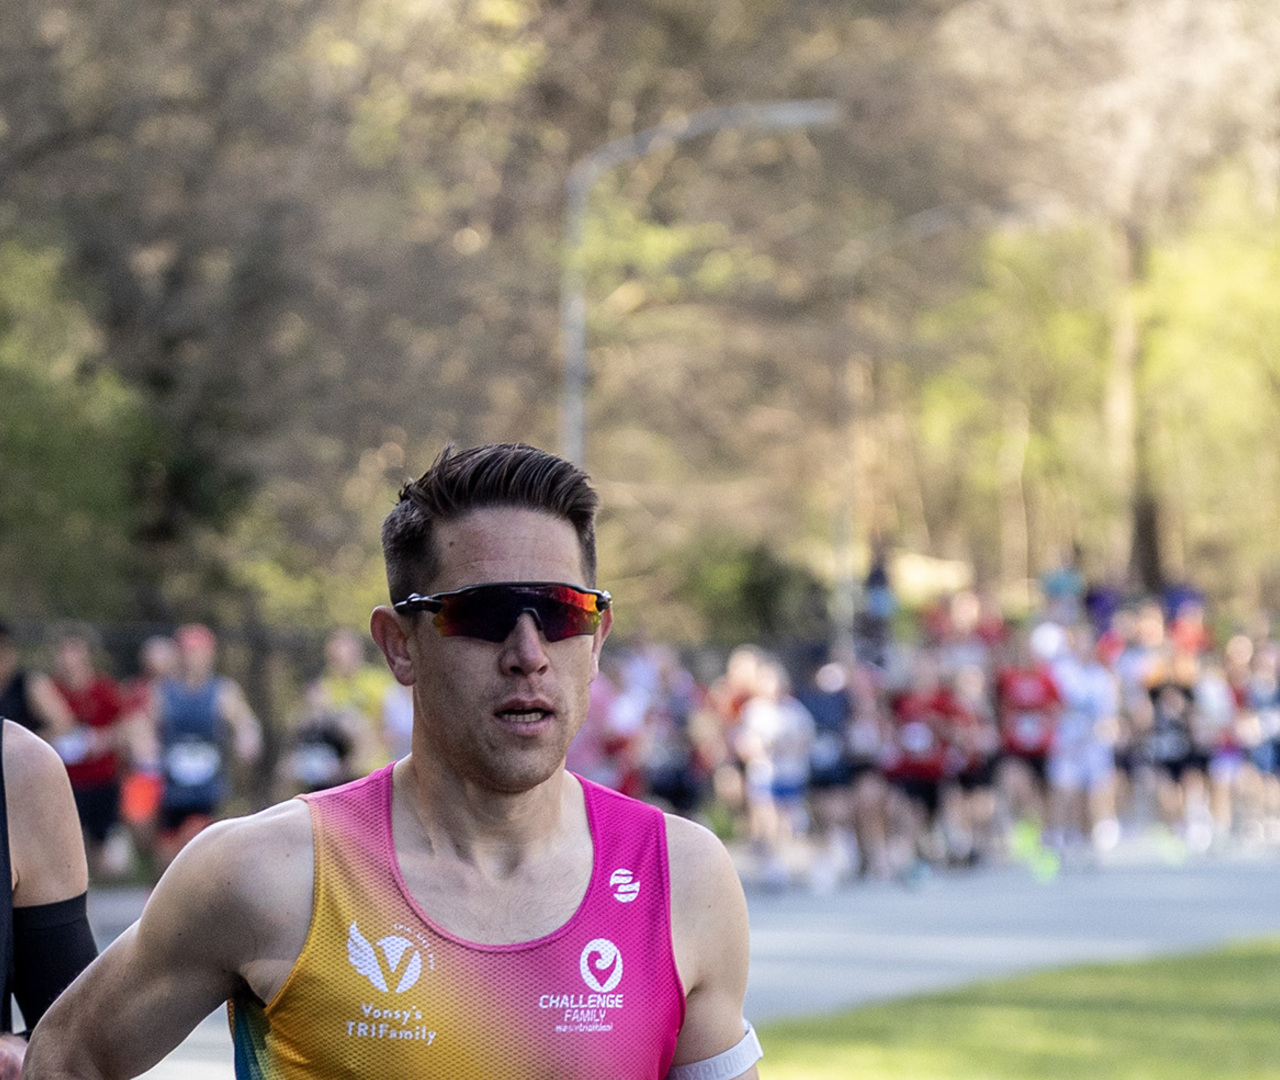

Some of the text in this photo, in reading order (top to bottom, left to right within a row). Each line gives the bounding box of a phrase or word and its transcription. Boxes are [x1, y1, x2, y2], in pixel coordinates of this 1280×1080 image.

[538, 994, 624, 1009] CHALLENGE
[361, 1003, 423, 1026] Vonsy's
[564, 1009, 606, 1022] FAMILY
[346, 1021, 437, 1046] TRIFamily
